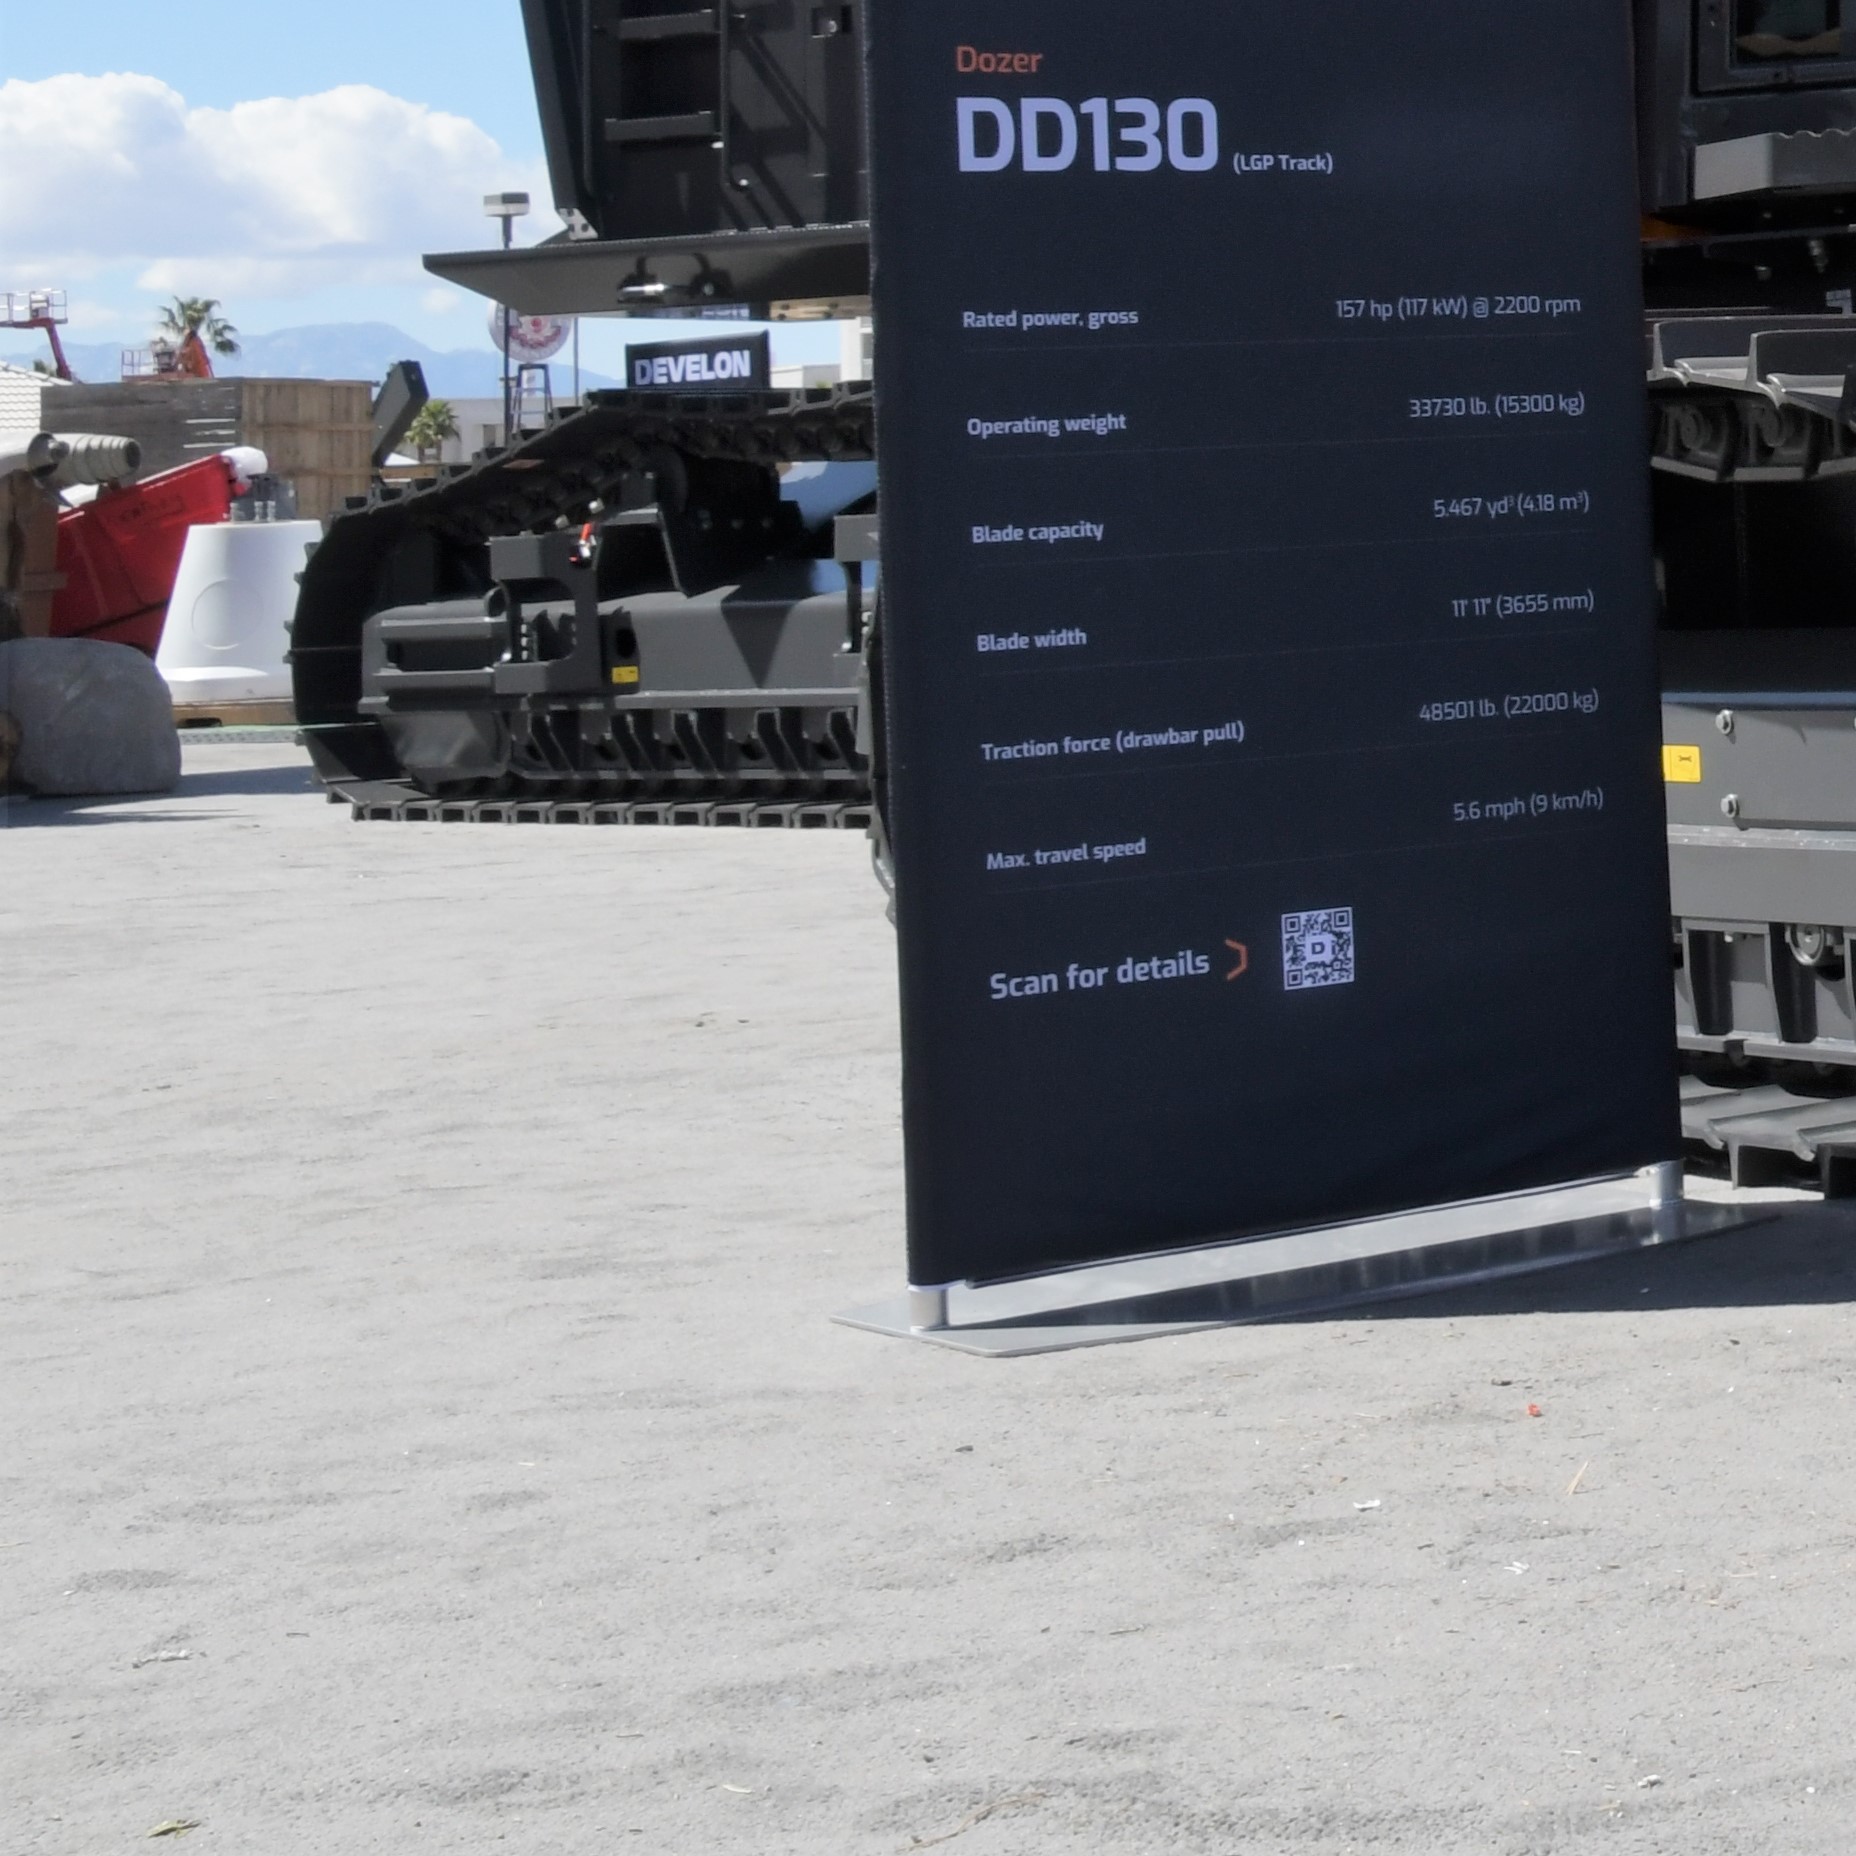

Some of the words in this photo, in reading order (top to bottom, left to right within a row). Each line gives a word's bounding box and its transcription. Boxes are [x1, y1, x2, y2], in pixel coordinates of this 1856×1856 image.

[957, 46, 1042, 73] Dozer
[957, 97, 1218, 171] DD130
[1234, 153, 1274, 174] (LGP
[1278, 153, 1333, 174] Track)
[963, 310, 1017, 327] Rated
[1088, 312, 1138, 329] gross
[1336, 300, 1365, 317] 157
[1371, 300, 1392, 321] hp
[1398, 297, 1427, 320] (117
[1433, 296, 1467, 318] kW)
[1473, 297, 1488, 318] @
[1495, 296, 1540, 314] 2200
[1545, 299, 1580, 317] rpm
[634, 350, 751, 385] DEVELON
[1410, 398, 1465, 417] 33730
[1471, 397, 1490, 414] lb.
[1495, 395, 1554, 417] (15300
[1559, 392, 1584, 416] kg)
[967, 416, 1060, 439] Operating
[1064, 413, 1126, 435] weight
[1434, 498, 1482, 517] 5.467
[972, 525, 1023, 543] Blade
[1029, 521, 1103, 543] capacity
[1496, 594, 1548, 618] (3655
[1553, 589, 1593, 612] mm)
[977, 633, 1029, 651] Blade
[1034, 628, 1086, 647] width
[1420, 701, 1474, 720] 48501
[1479, 699, 1500, 717] lb.
[1504, 693, 1568, 718] (22000
[1573, 688, 1598, 713] kg)
[981, 740, 1058, 760] Traction
[1063, 737, 1110, 753] force
[1116, 728, 1198, 753] (drawbar
[1203, 721, 1244, 746] pull)
[1454, 802, 1480, 821] 5.6
[1486, 797, 1525, 820] mph
[1531, 794, 1547, 816] (9
[1553, 787, 1603, 809] km/h)
[987, 853, 1030, 869] Max.
[1035, 843, 1089, 864] travel
[1093, 838, 1146, 862] speed
[991, 973, 1058, 999] Scan
[1067, 964, 1108, 989] for
[1117, 950, 1209, 983] details
